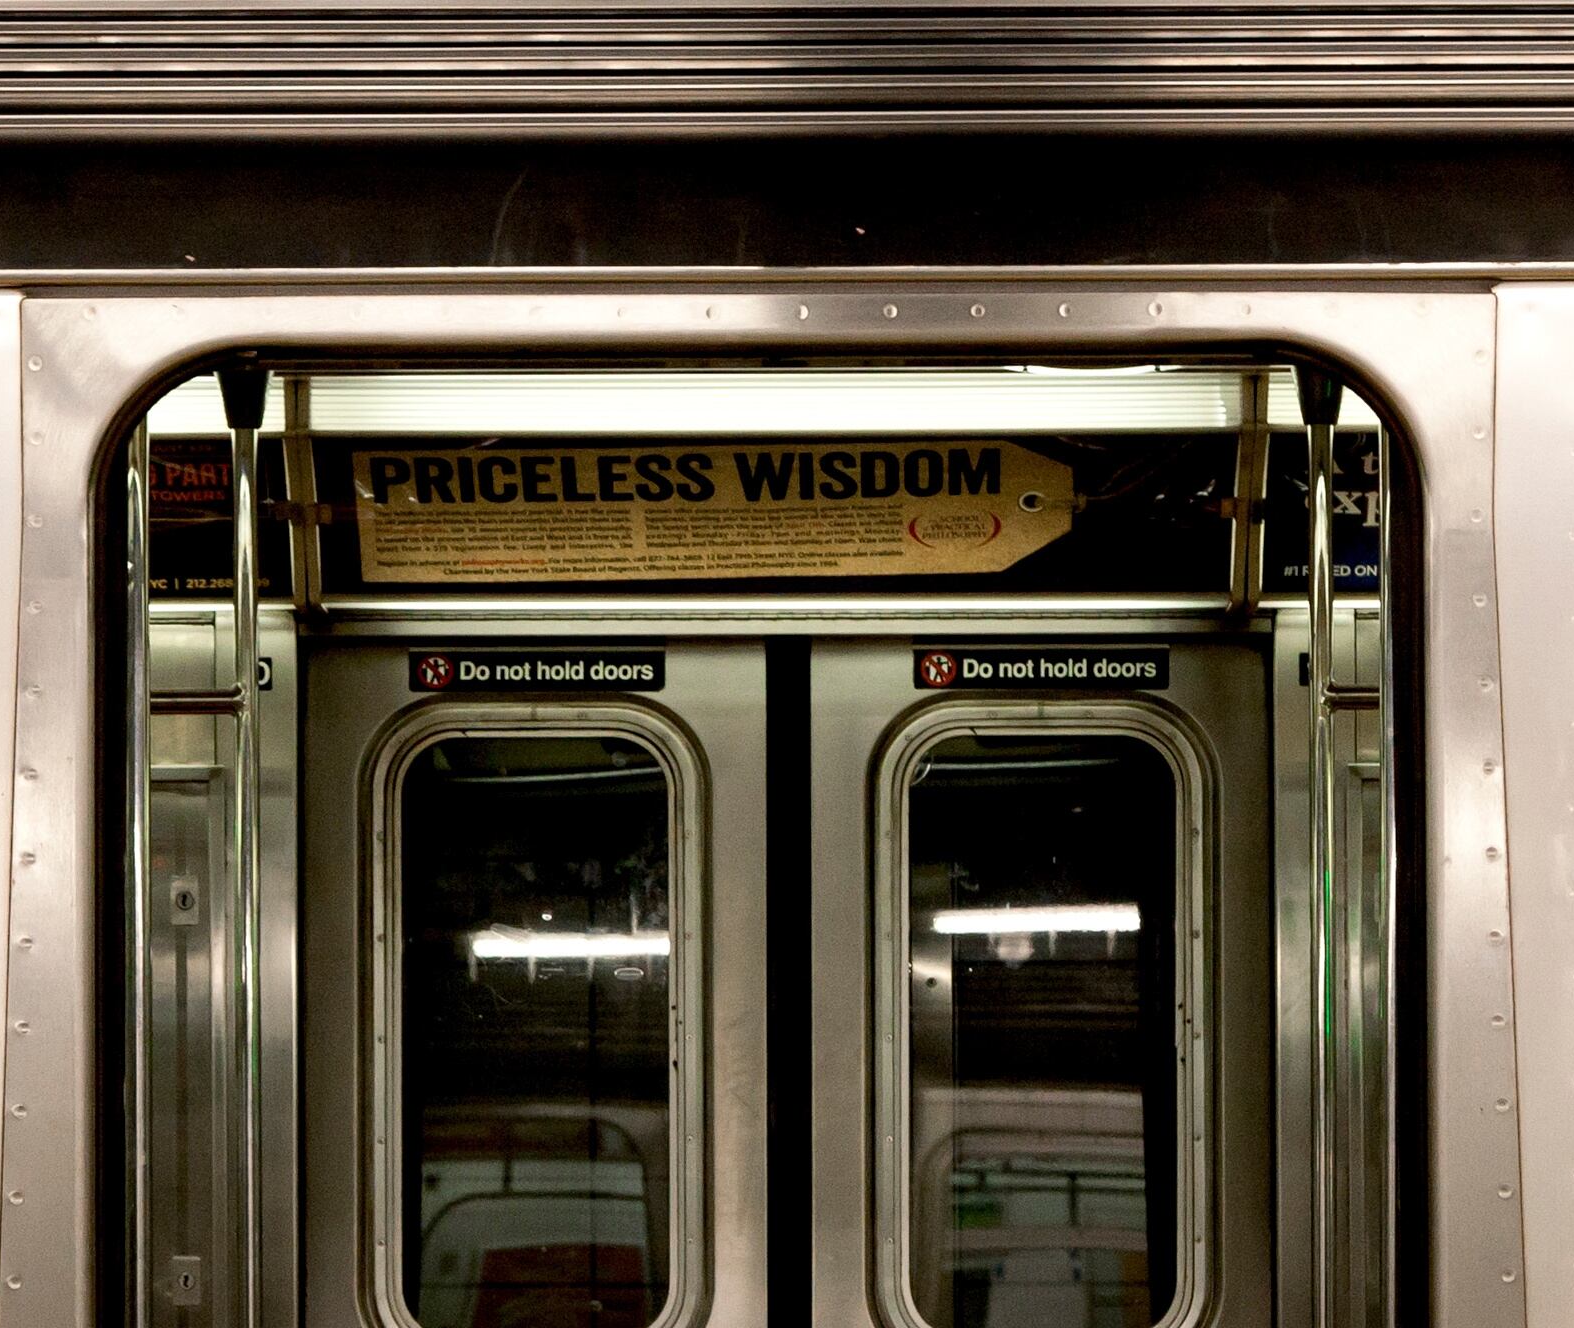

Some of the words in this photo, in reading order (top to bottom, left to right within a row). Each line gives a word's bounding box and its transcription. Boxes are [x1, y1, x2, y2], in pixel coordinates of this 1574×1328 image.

[369, 453, 715, 504] PRICELESS
[732, 448, 1001, 501] WISDOM
[1301, 564, 1352, 577] RED
[459, 660, 490, 681] Do
[495, 662, 531, 681] not
[537, 660, 584, 680] hold
[590, 659, 654, 680] doors
[962, 658, 993, 678] Do
[998, 659, 1034, 678] not
[1040, 658, 1087, 678] hold
[1093, 658, 1157, 678] doors
